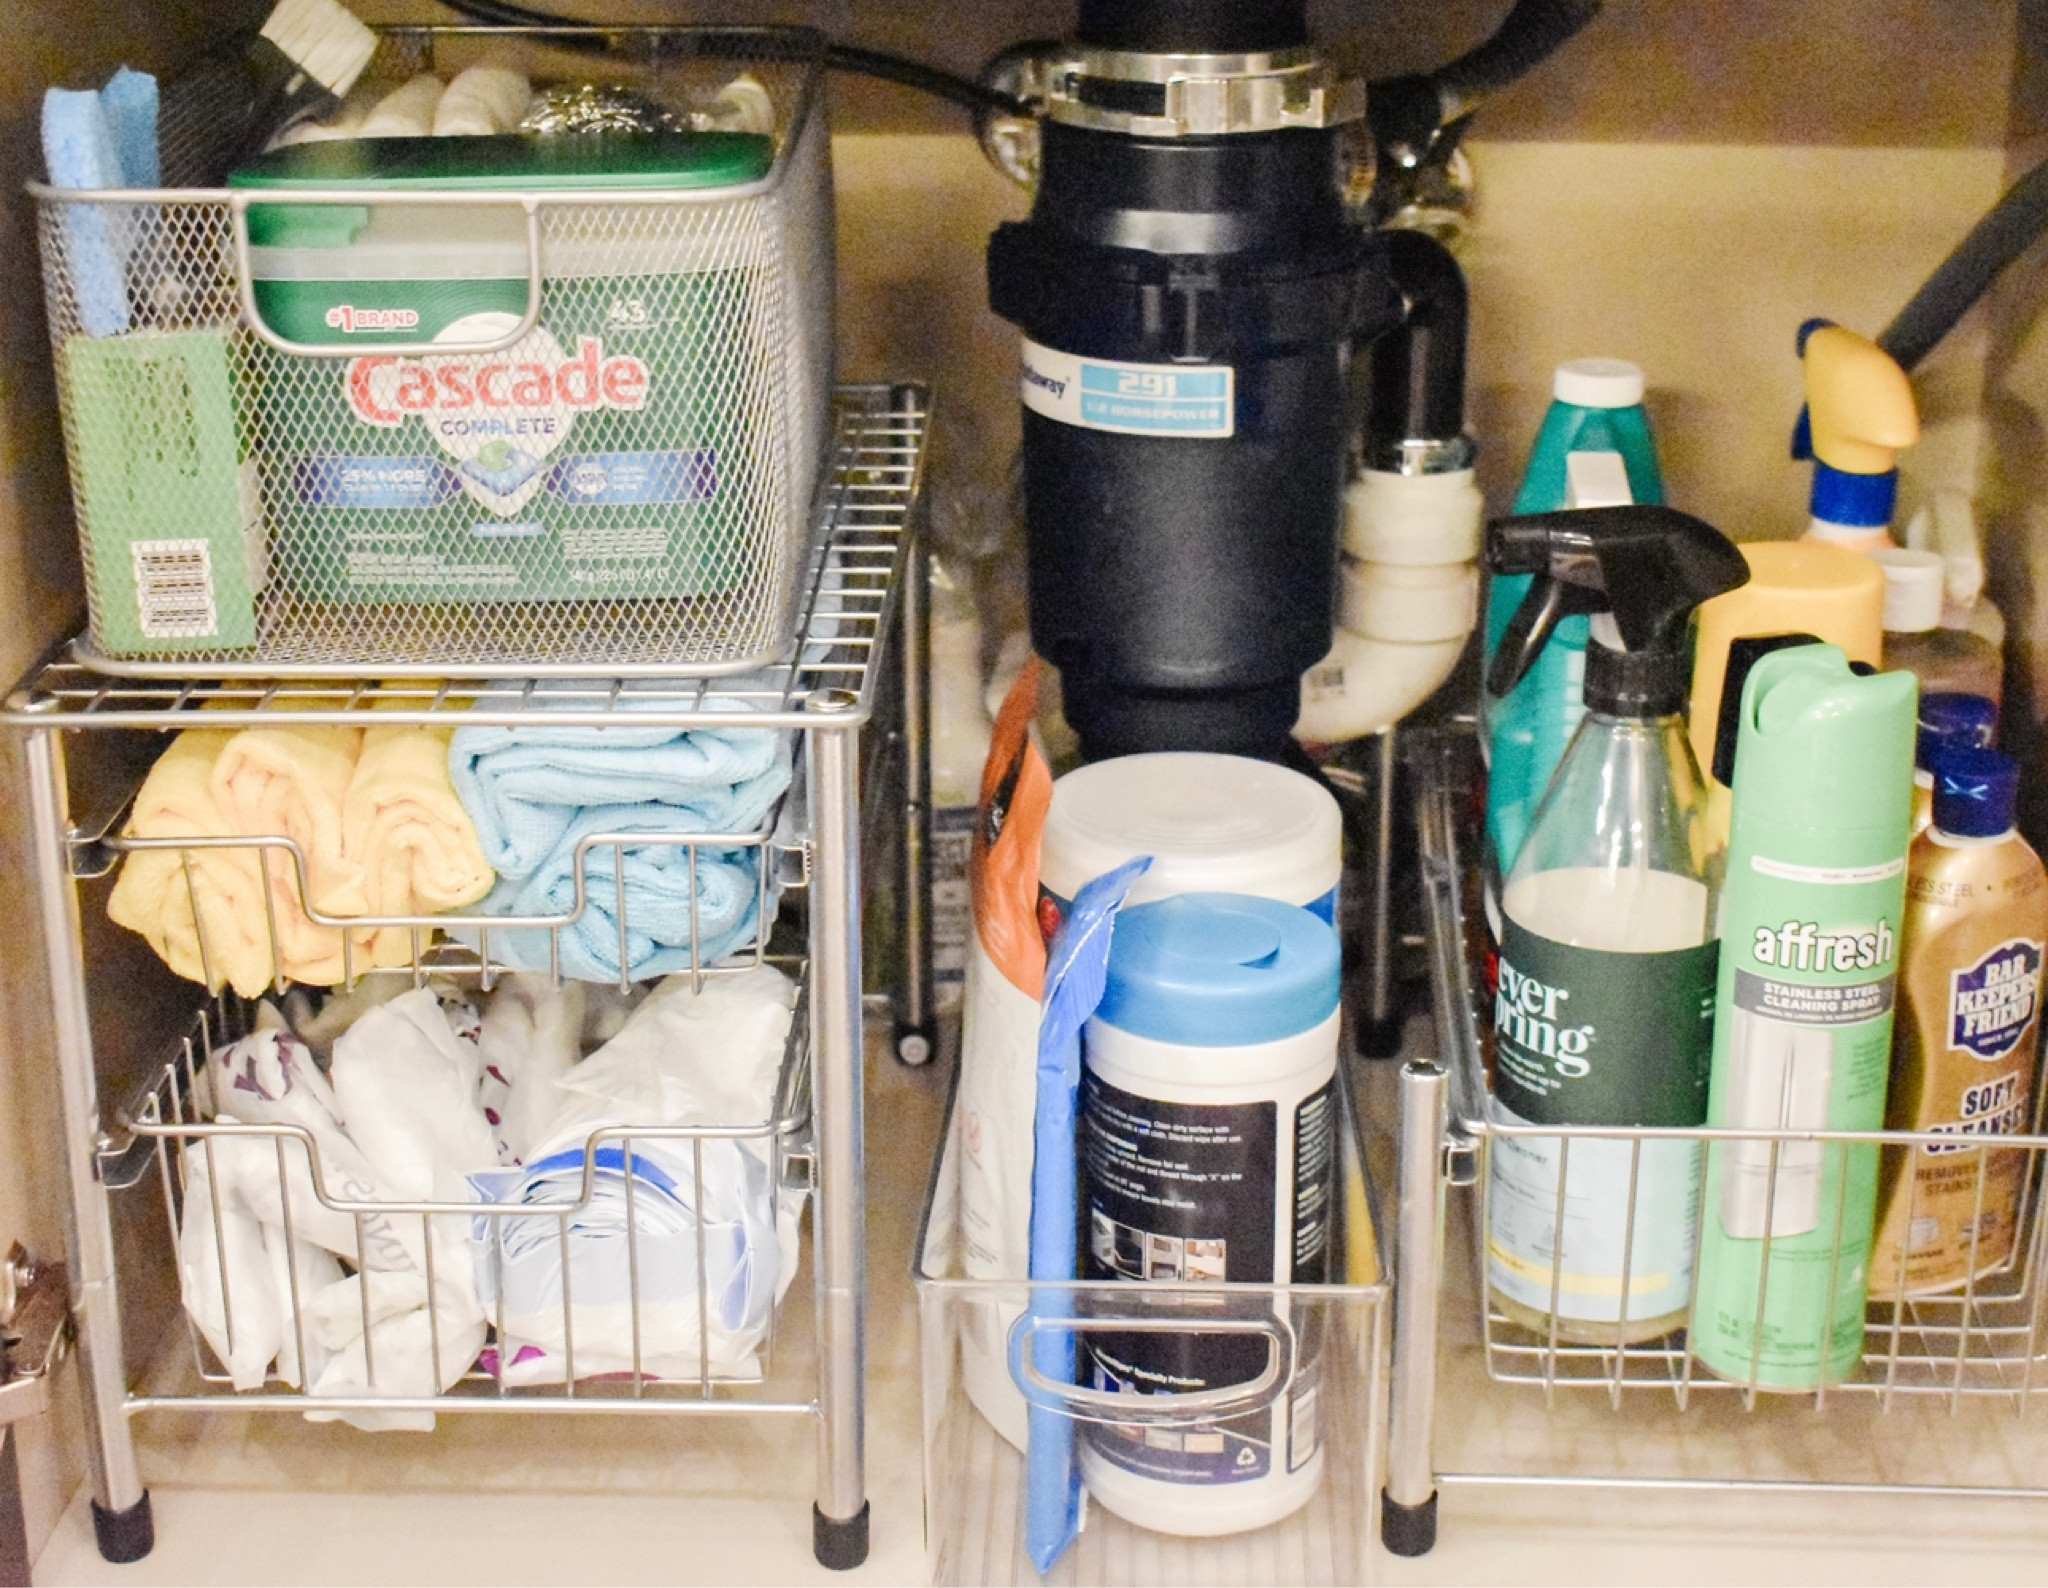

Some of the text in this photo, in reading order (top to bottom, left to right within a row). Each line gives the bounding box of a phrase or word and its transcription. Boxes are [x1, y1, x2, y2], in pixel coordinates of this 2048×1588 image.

[327, 306, 417, 331] #1 BRAND
[350, 339, 646, 421] Cascade
[1118, 371, 1177, 397] 291
[440, 418, 556, 436] COMPLETE
[1110, 404, 1220, 420] HORSEPOWER
[1753, 918, 1894, 973] affresh
[1985, 953, 2027, 987] BAR
[1763, 982, 1881, 1000] STAINLESS STEEL
[1763, 996, 1881, 1012] CLEANING SPRAY
[1957, 973, 2038, 1016] KEEPERS
[1495, 988, 1595, 1078] pring
[1963, 995, 2033, 1038] FRIEND
[1963, 1075, 2018, 1117] SOFT
